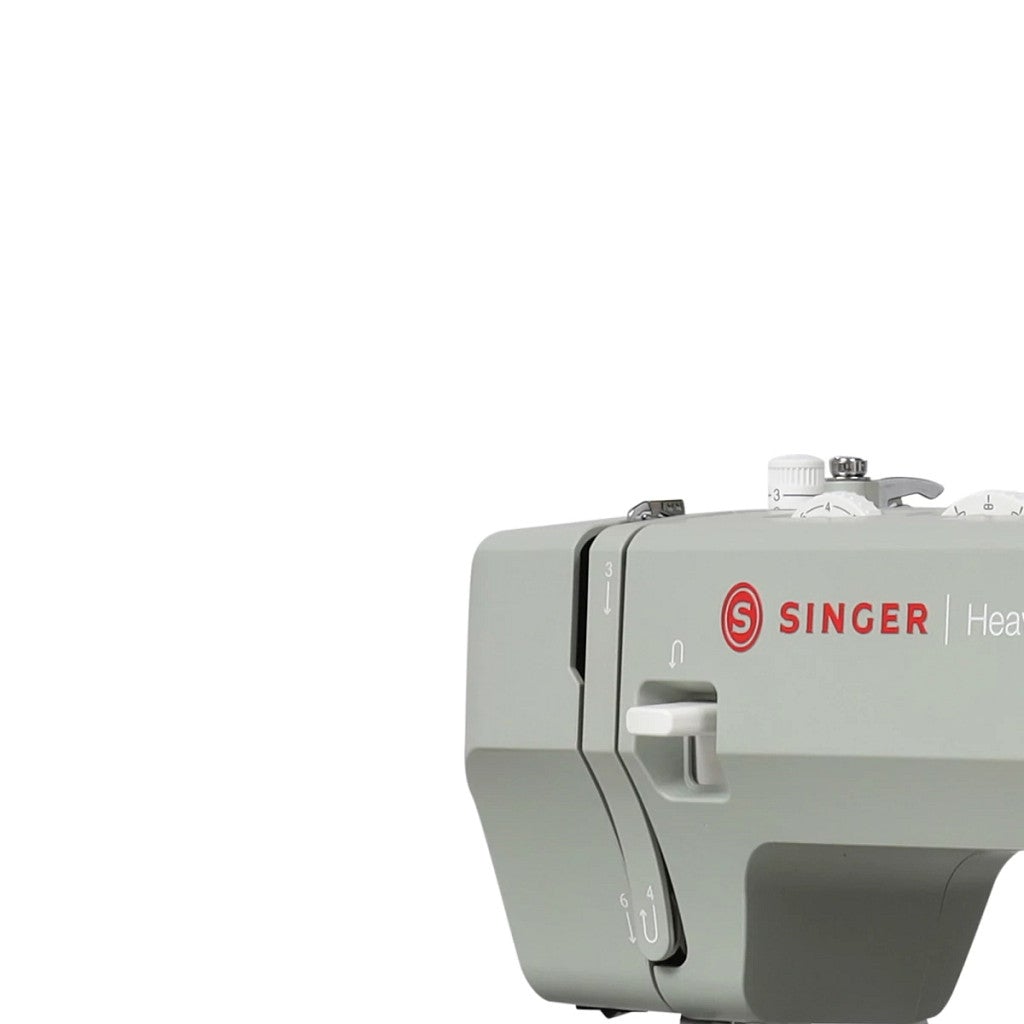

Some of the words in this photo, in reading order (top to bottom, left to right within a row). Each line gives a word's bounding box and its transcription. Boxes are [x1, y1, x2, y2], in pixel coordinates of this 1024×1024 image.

[773, 488, 781, 501] 3
[825, 501, 831, 512] 4
[604, 561, 613, 577] 3
[779, 601, 929, 635] SINGER
[646, 885, 654, 900] 4
[620, 893, 629, 908] 6
